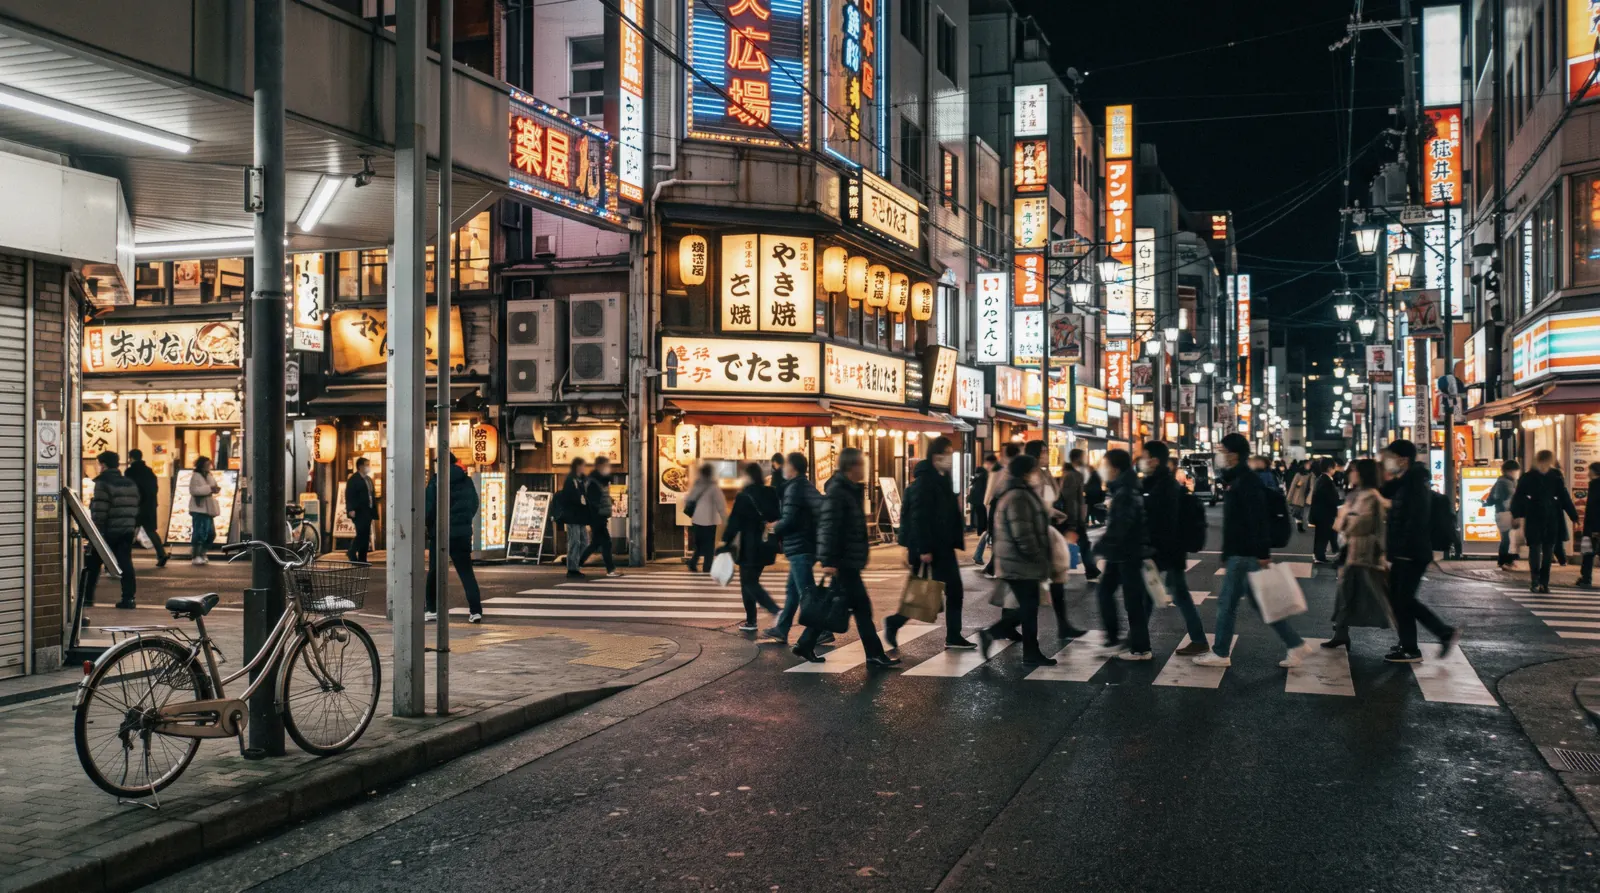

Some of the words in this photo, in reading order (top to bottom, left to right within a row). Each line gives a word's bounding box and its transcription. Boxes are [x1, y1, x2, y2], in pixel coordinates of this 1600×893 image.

[508, 111, 570, 190] 楽屋
[717, 352, 800, 382] でたま
